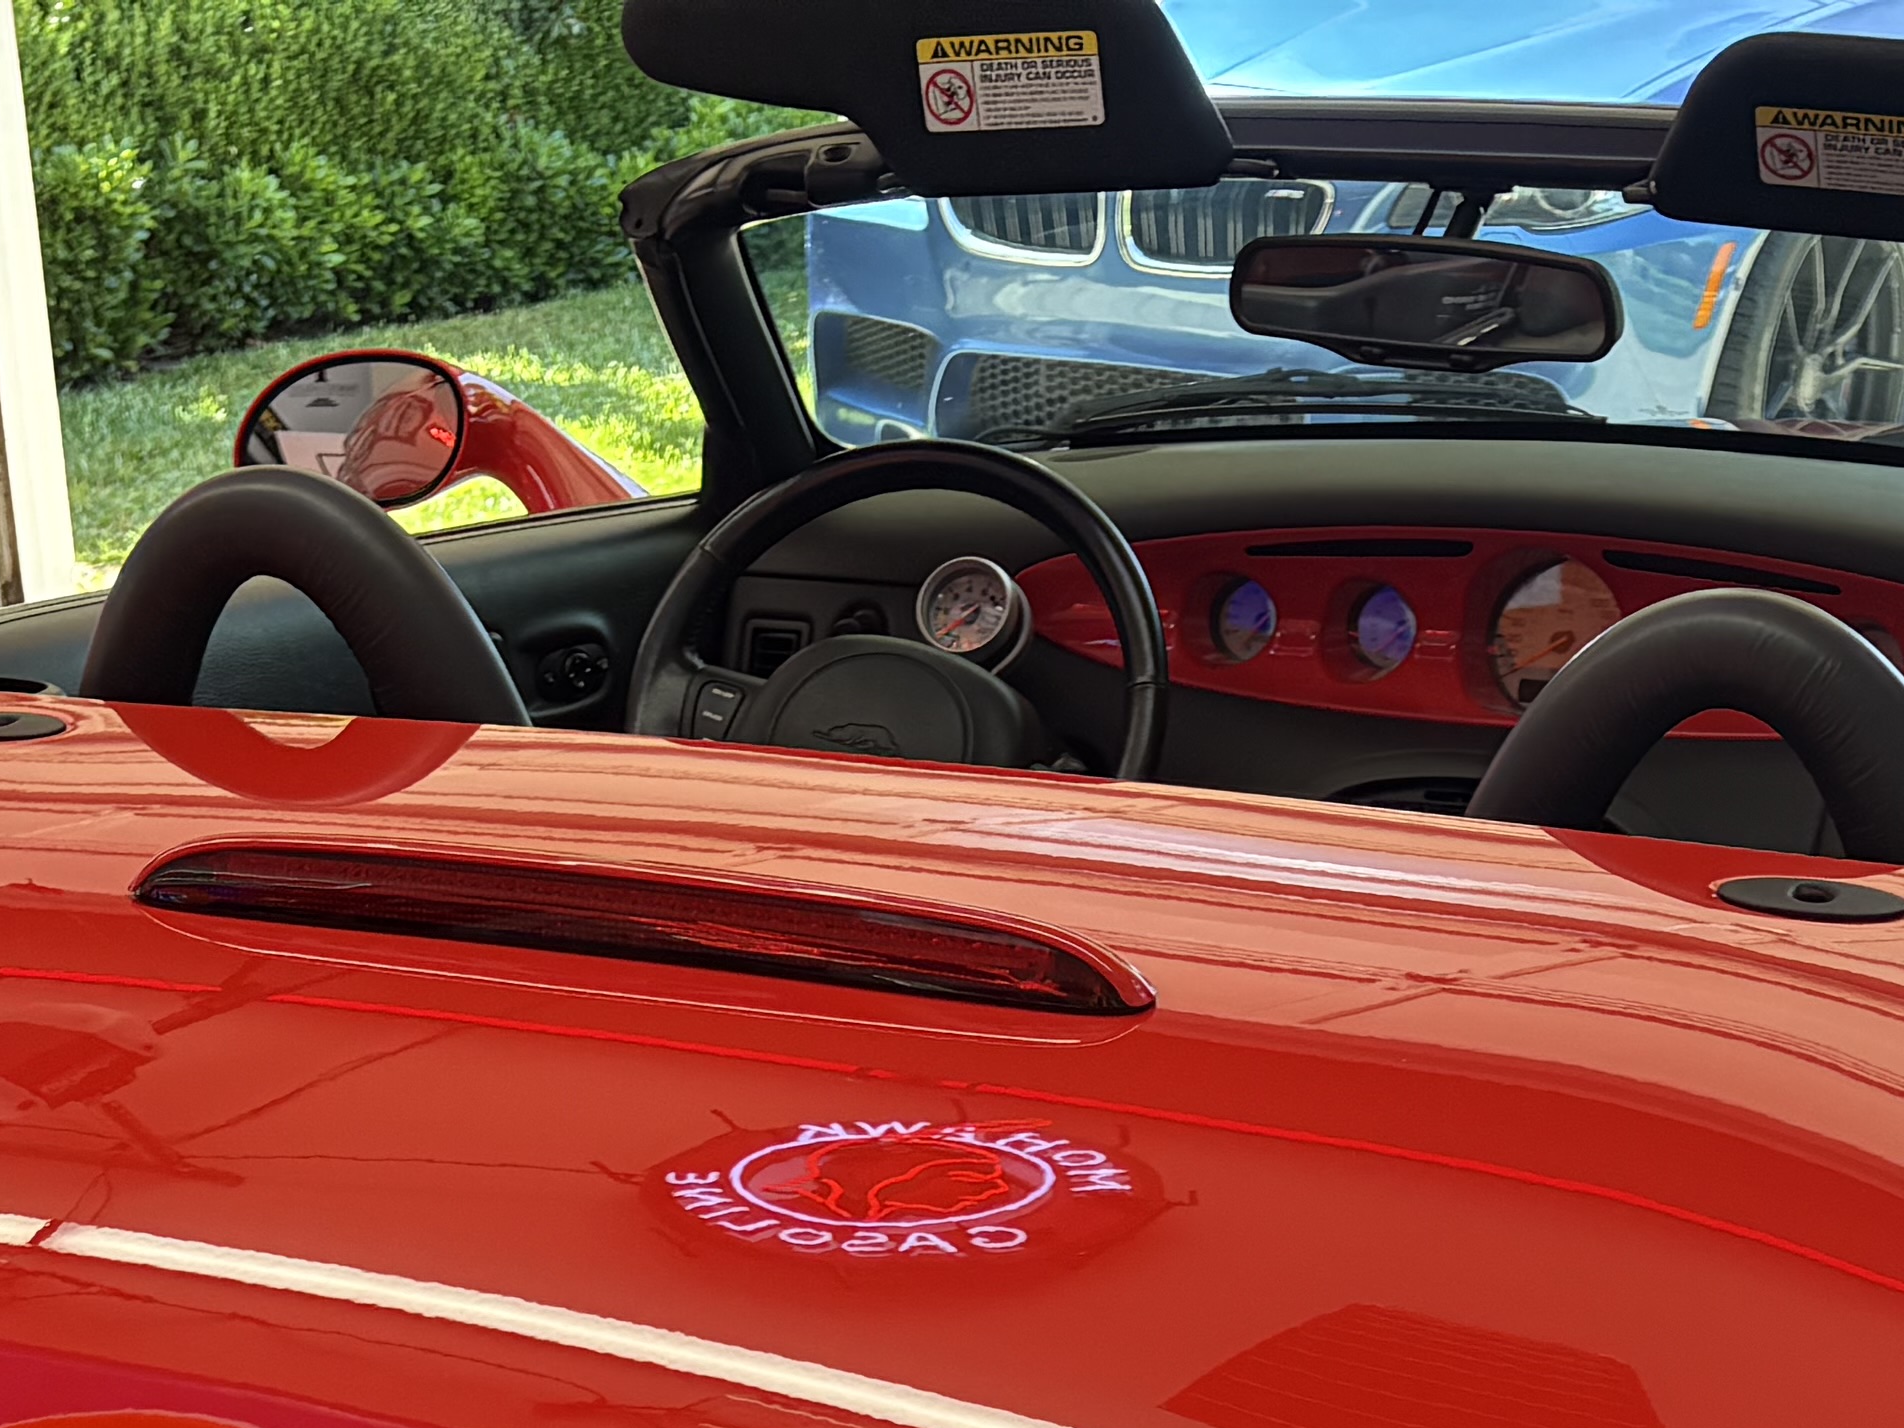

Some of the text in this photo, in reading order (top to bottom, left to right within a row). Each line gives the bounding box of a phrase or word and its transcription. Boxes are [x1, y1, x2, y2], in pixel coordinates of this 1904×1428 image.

[948, 35, 1084, 58] WARNING
[979, 58, 1093, 73] DEATH OR SERIOUS
[979, 68, 1095, 83] INJURY CAN OCCUR
